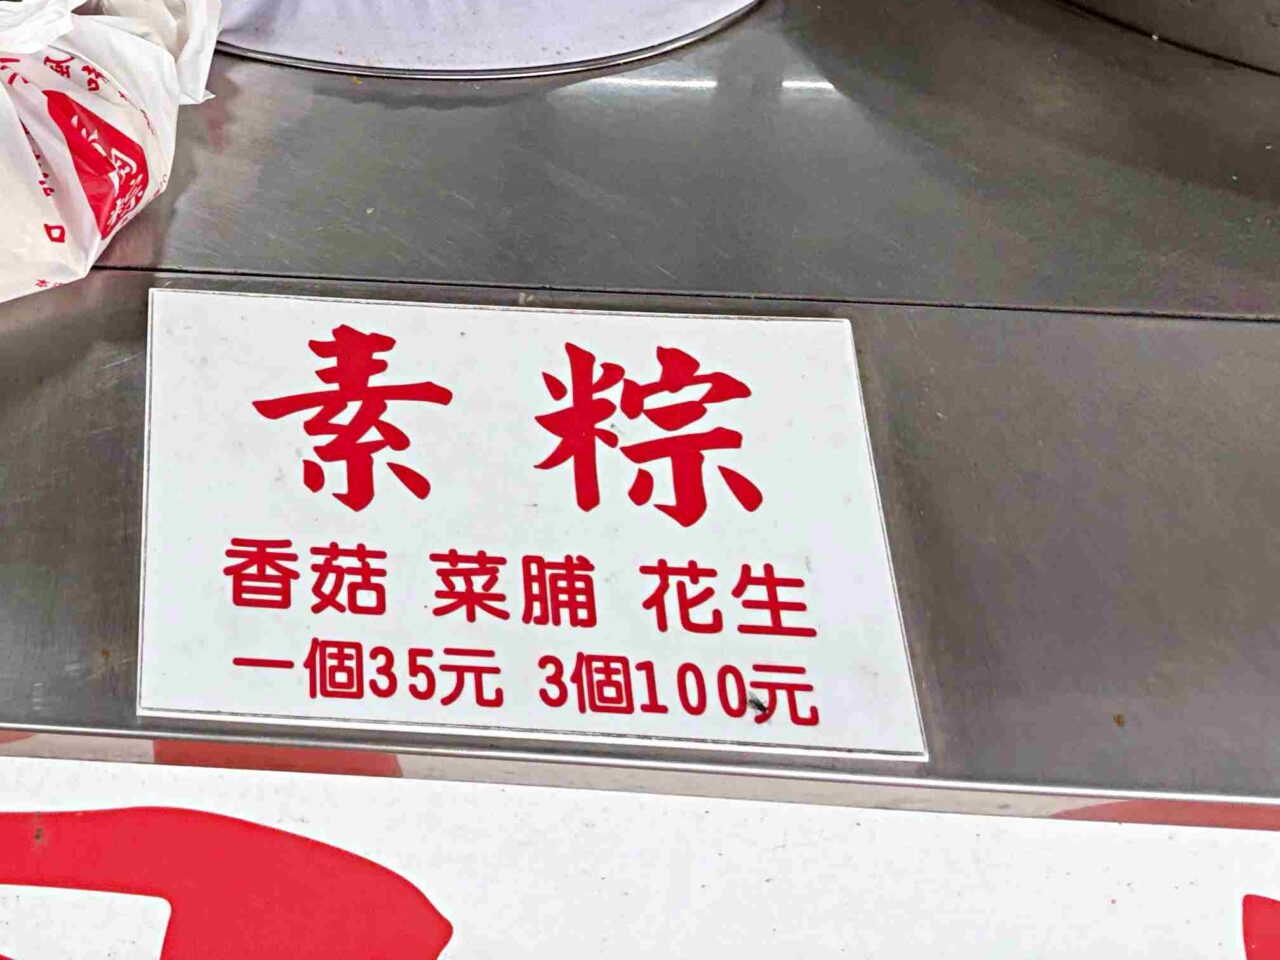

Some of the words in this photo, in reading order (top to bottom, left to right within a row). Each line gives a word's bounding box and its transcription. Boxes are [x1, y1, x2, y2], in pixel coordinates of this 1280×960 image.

[251, 324, 763, 529] 素粽
[223, 537, 387, 616] 香菇
[428, 548, 597, 629] 菜脯
[639, 558, 817, 638] 花生
[232, 638, 504, 708] 一個35元
[537, 651, 820, 727] 3個100元
